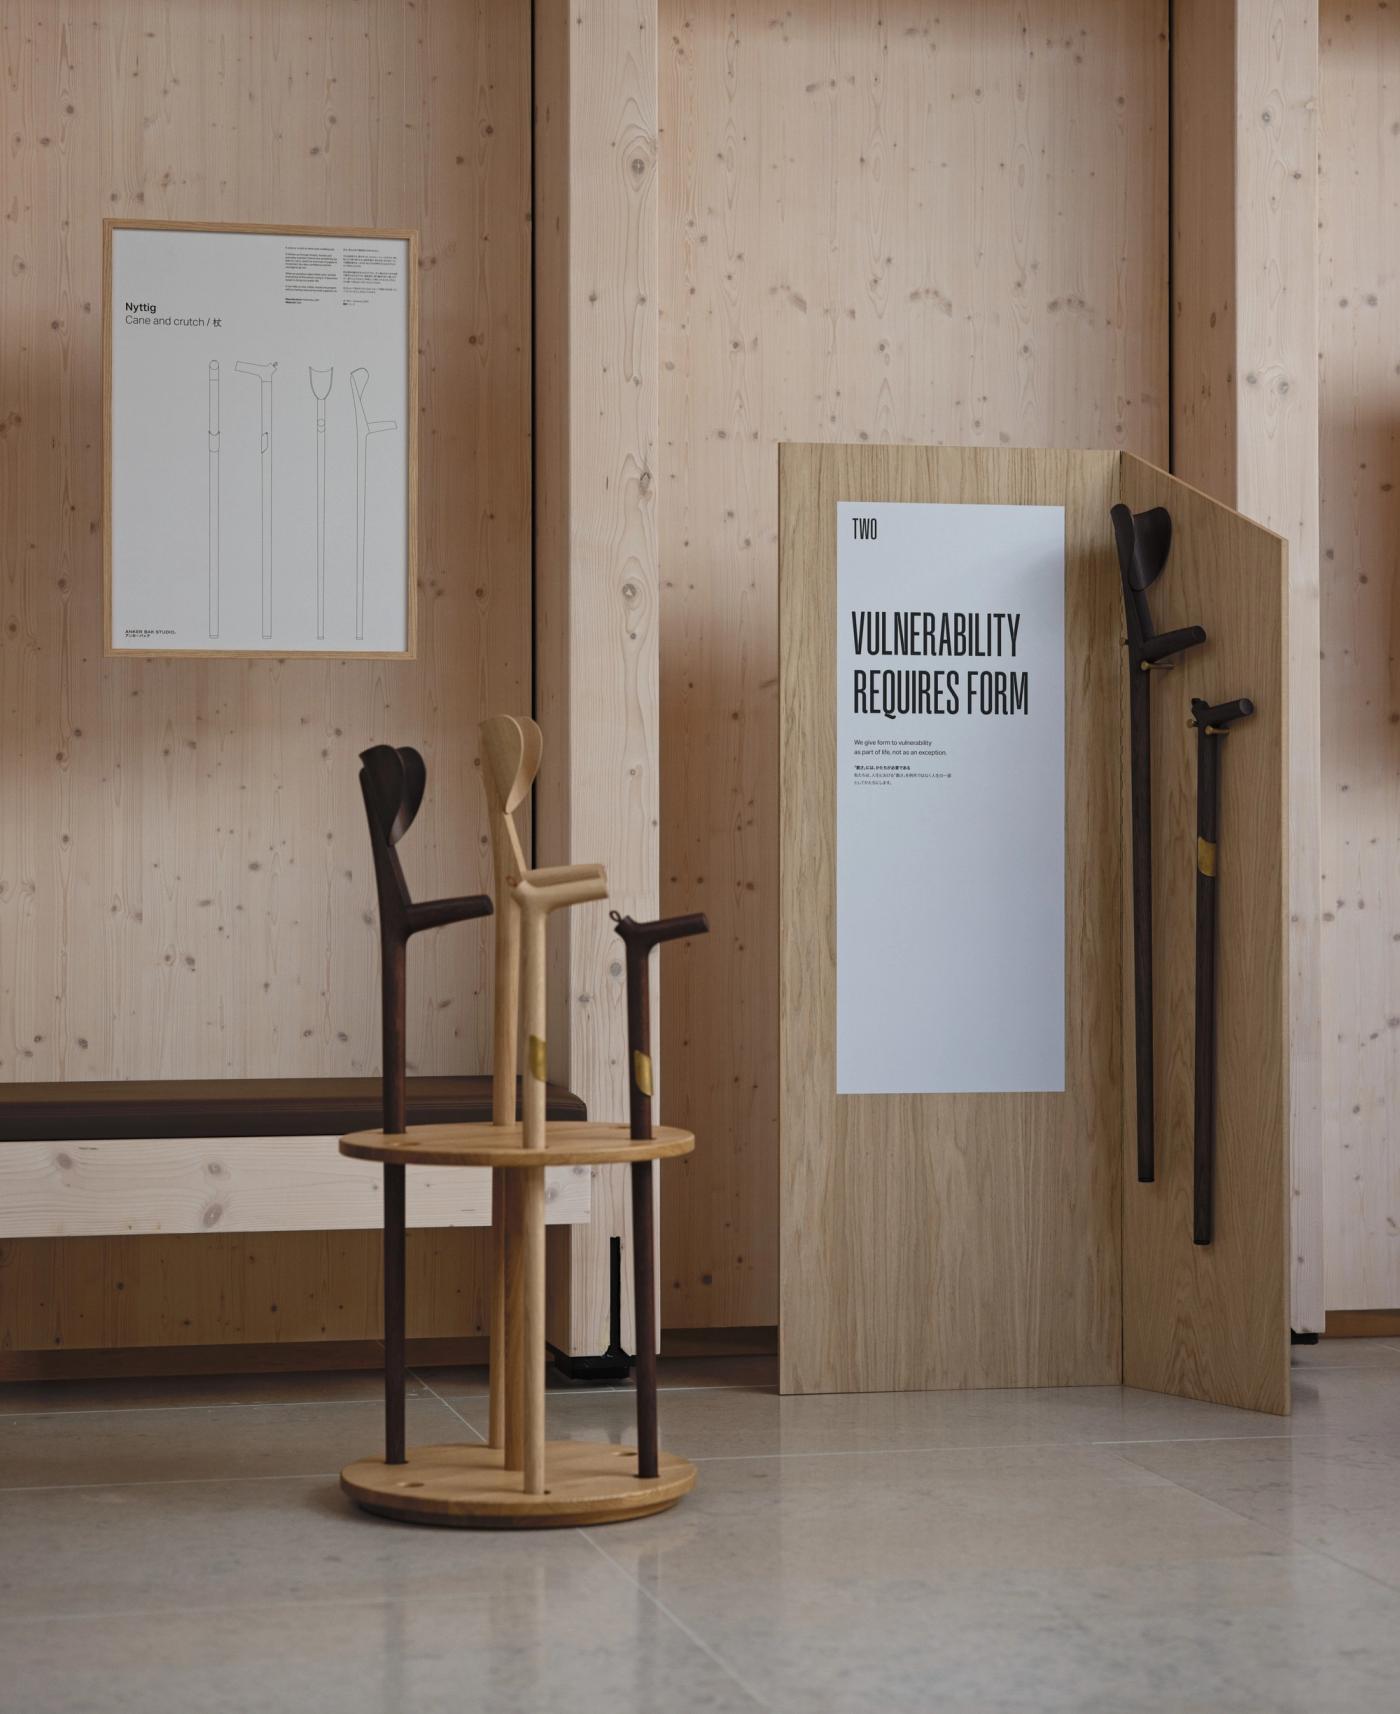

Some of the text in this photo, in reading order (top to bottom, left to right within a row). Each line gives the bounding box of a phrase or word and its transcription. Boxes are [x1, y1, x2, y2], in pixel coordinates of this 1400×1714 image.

[125, 302, 157, 314] Nyttig
[125, 315, 151, 325] Cane
[153, 317, 172, 326] and
[173, 318, 205, 327] crutch
[852, 518, 878, 540] TWO
[851, 611, 1021, 658] VULNERABILITY
[853, 670, 1029, 719] REQUIRES FORM
[864, 739, 877, 747] give
[898, 739, 933, 747] vulnerability
[861, 749, 874, 757] part
